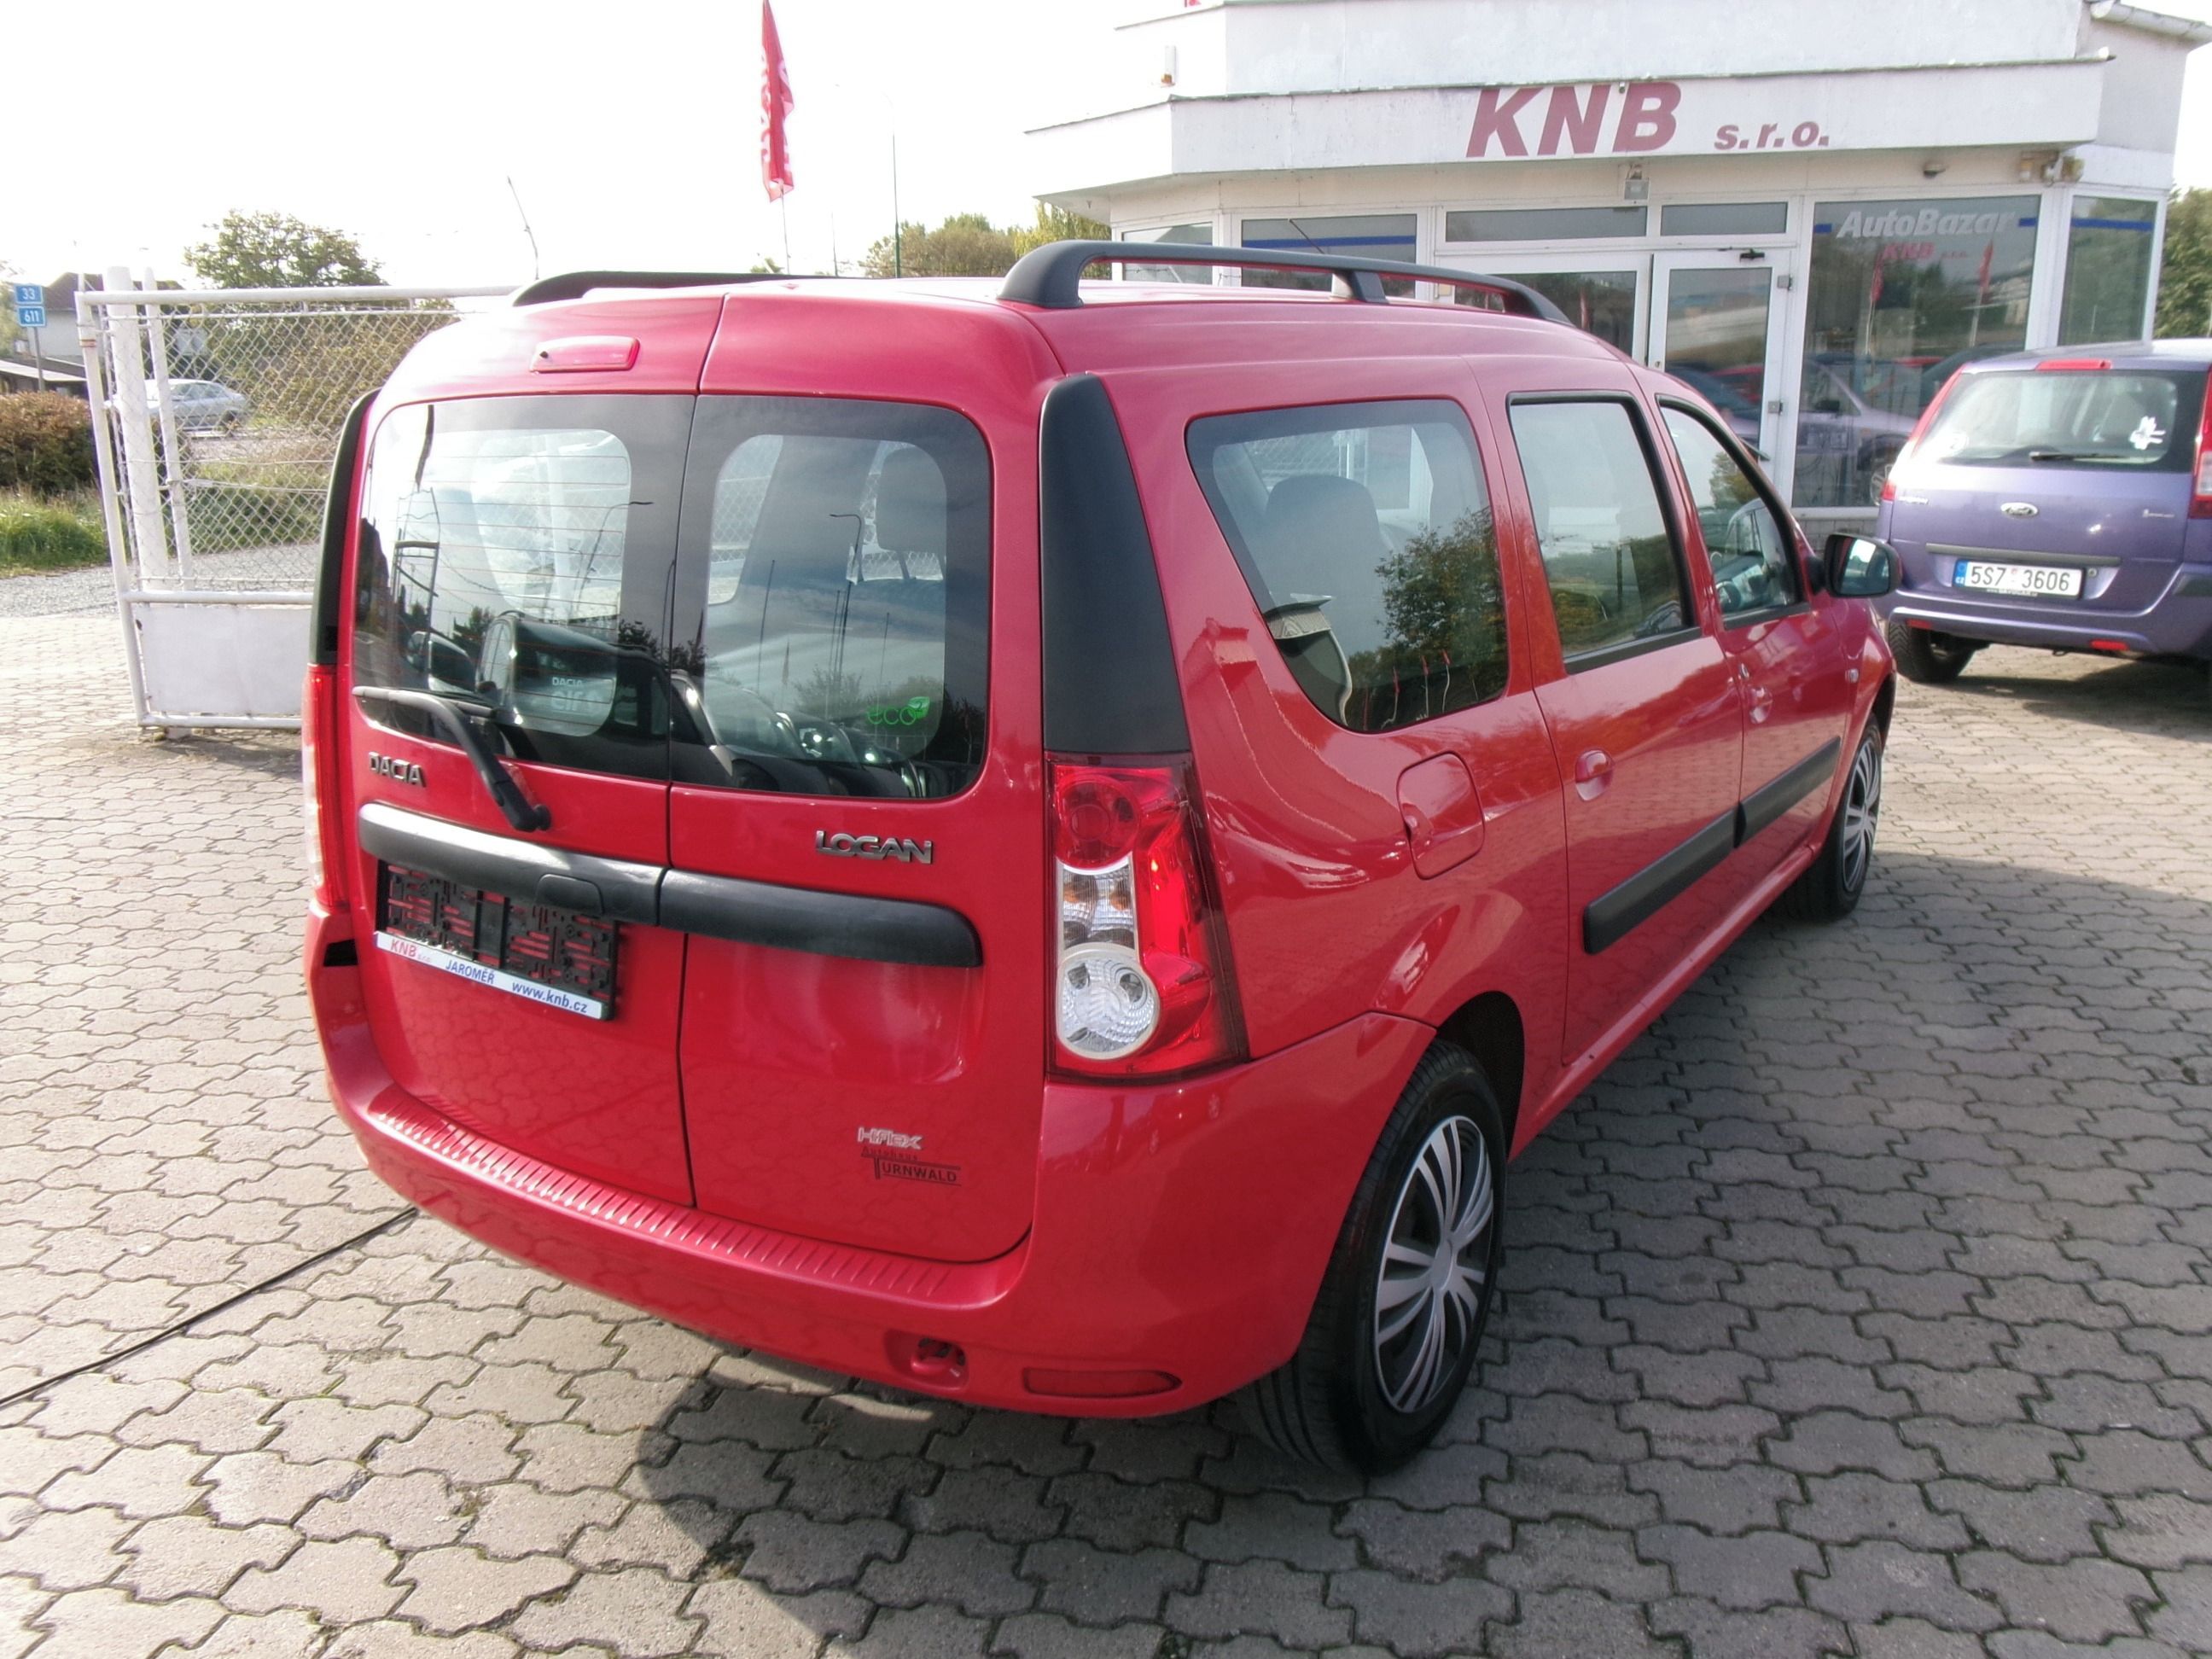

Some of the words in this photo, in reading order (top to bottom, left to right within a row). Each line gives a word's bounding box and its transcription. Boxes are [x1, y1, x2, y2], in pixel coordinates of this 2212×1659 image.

[1466, 81, 1681, 157] KNB
[1714, 121, 1830, 150] s.r.o.
[1837, 208, 2016, 238] AutoBazar
[21, 288, 36, 300] 33
[25, 310, 39, 323] 611
[1970, 566, 2007, 586] 5S7
[2022, 569, 2071, 591] 3606
[551, 676, 584, 687] DACIA
[368, 751, 427, 788] DACIA
[815, 830, 934, 864] LOGAN
[390, 938, 417, 958] KNB
[511, 981, 588, 1014] www.knb.cz
